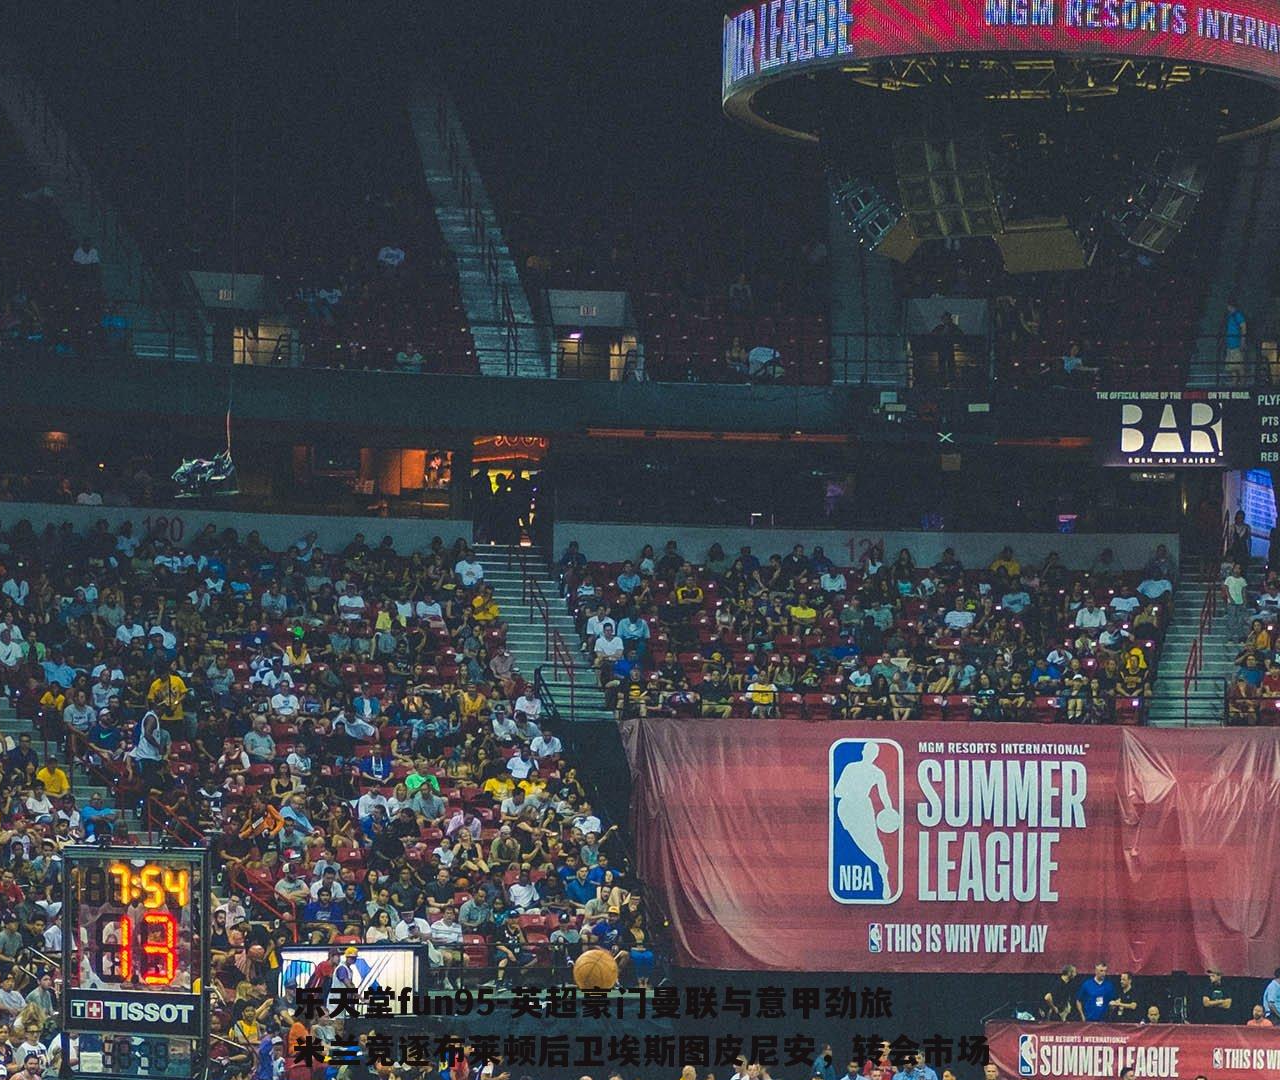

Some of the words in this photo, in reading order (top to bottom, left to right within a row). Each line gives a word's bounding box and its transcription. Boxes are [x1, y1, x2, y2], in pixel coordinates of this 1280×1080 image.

[759, 0, 852, 70] LEAGUE
[1261, 416, 1279, 426] PTS
[1261, 432, 1278, 443] FLS
[1261, 452, 1279, 462] REB
[919, 742, 944, 754] MGM
[948, 743, 997, 754] RESORTS
[917, 759, 1087, 828] SUMMER
[839, 865, 874, 892] NBA
[918, 831, 1060, 902] LEAGUE
[109, 863, 189, 908] 7:54
[119, 912, 178, 985] 13
[885, 924, 922, 952] THIS
[926, 925, 941, 952] IS
[945, 925, 981, 953] WHY
[984, 925, 1008, 953] WE
[1011, 925, 1048, 953] PLAY
[107, 1003, 194, 1024] TISSOT
[1040, 1045, 1114, 1077] SUMMER
[1118, 1046, 1179, 1077] LEAGUE
[1224, 1048, 1251, 1069] THIS
[1253, 1049, 1265, 1070] IS
